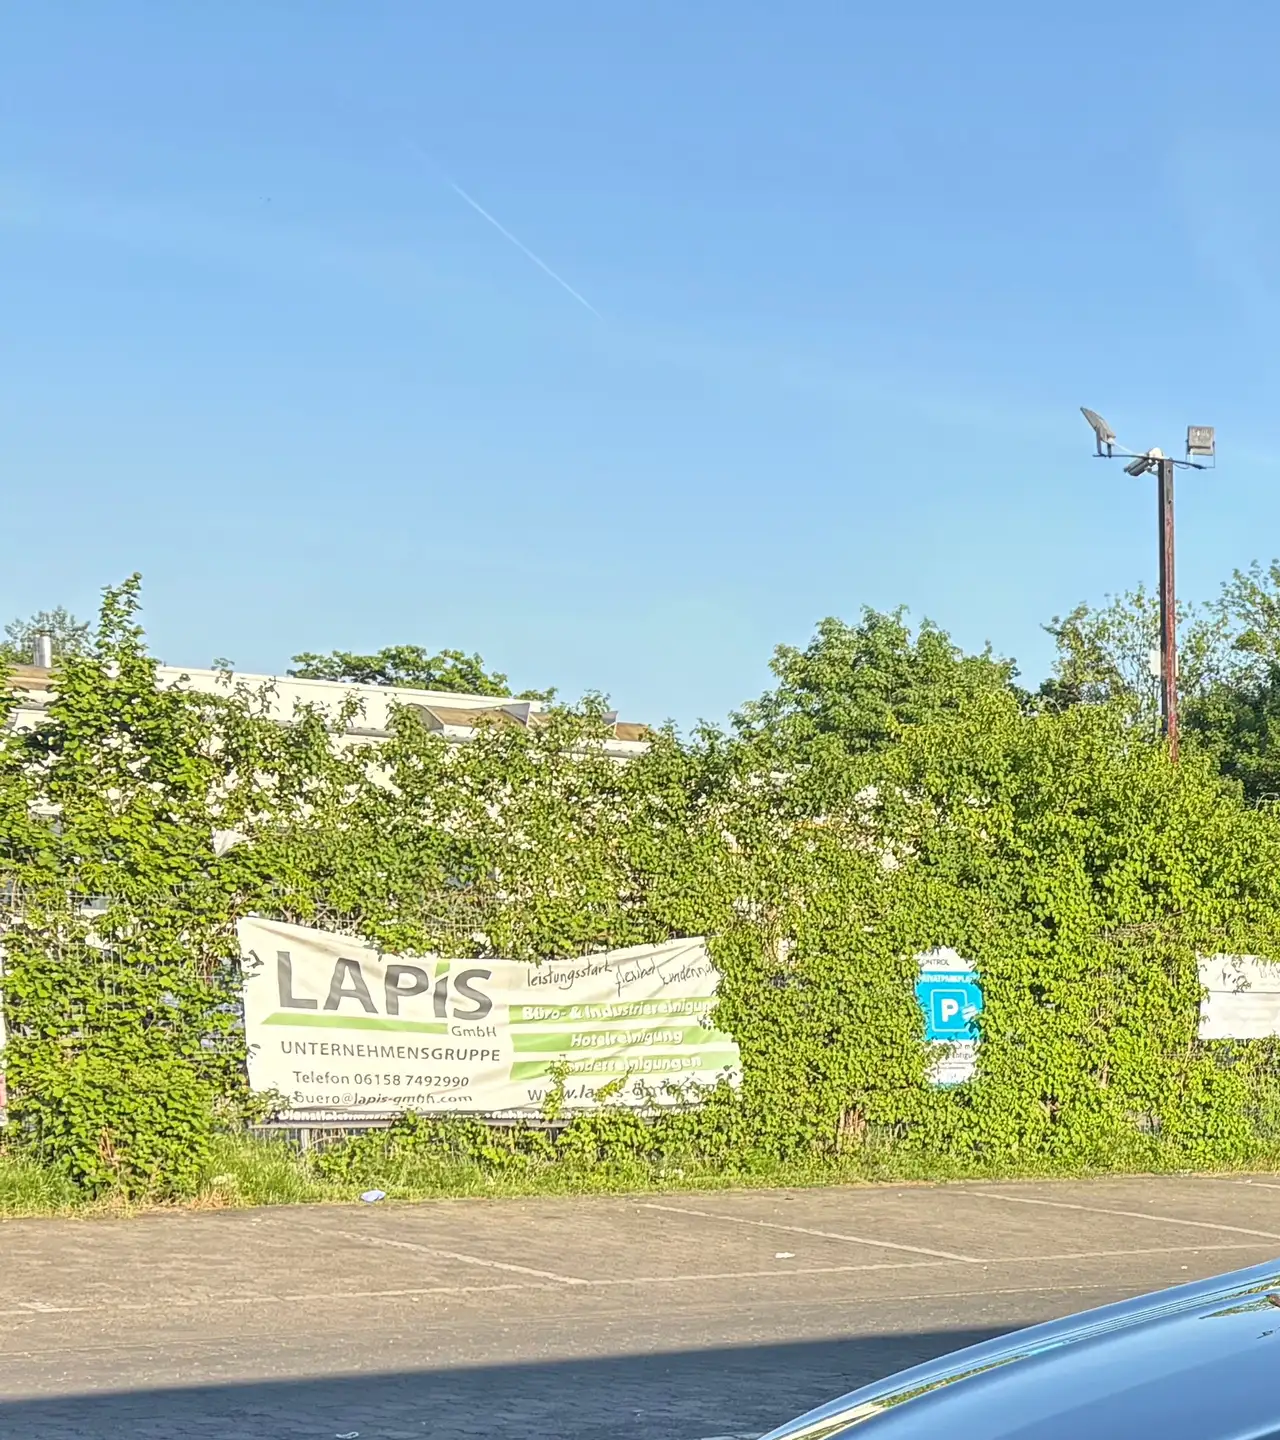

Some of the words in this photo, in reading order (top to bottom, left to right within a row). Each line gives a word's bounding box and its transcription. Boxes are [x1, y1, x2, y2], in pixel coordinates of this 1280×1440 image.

[528, 954, 612, 990] leistungsstark
[570, 1005, 583, 1020] &
[940, 998, 960, 1023] P
[451, 1025, 497, 1038] GmbH
[281, 1040, 501, 1062] UNTERNEHMENSGRUPPE
[292, 1070, 350, 1085] Telefon
[354, 1073, 401, 1086] 06158
[406, 1075, 470, 1087] 7492990
